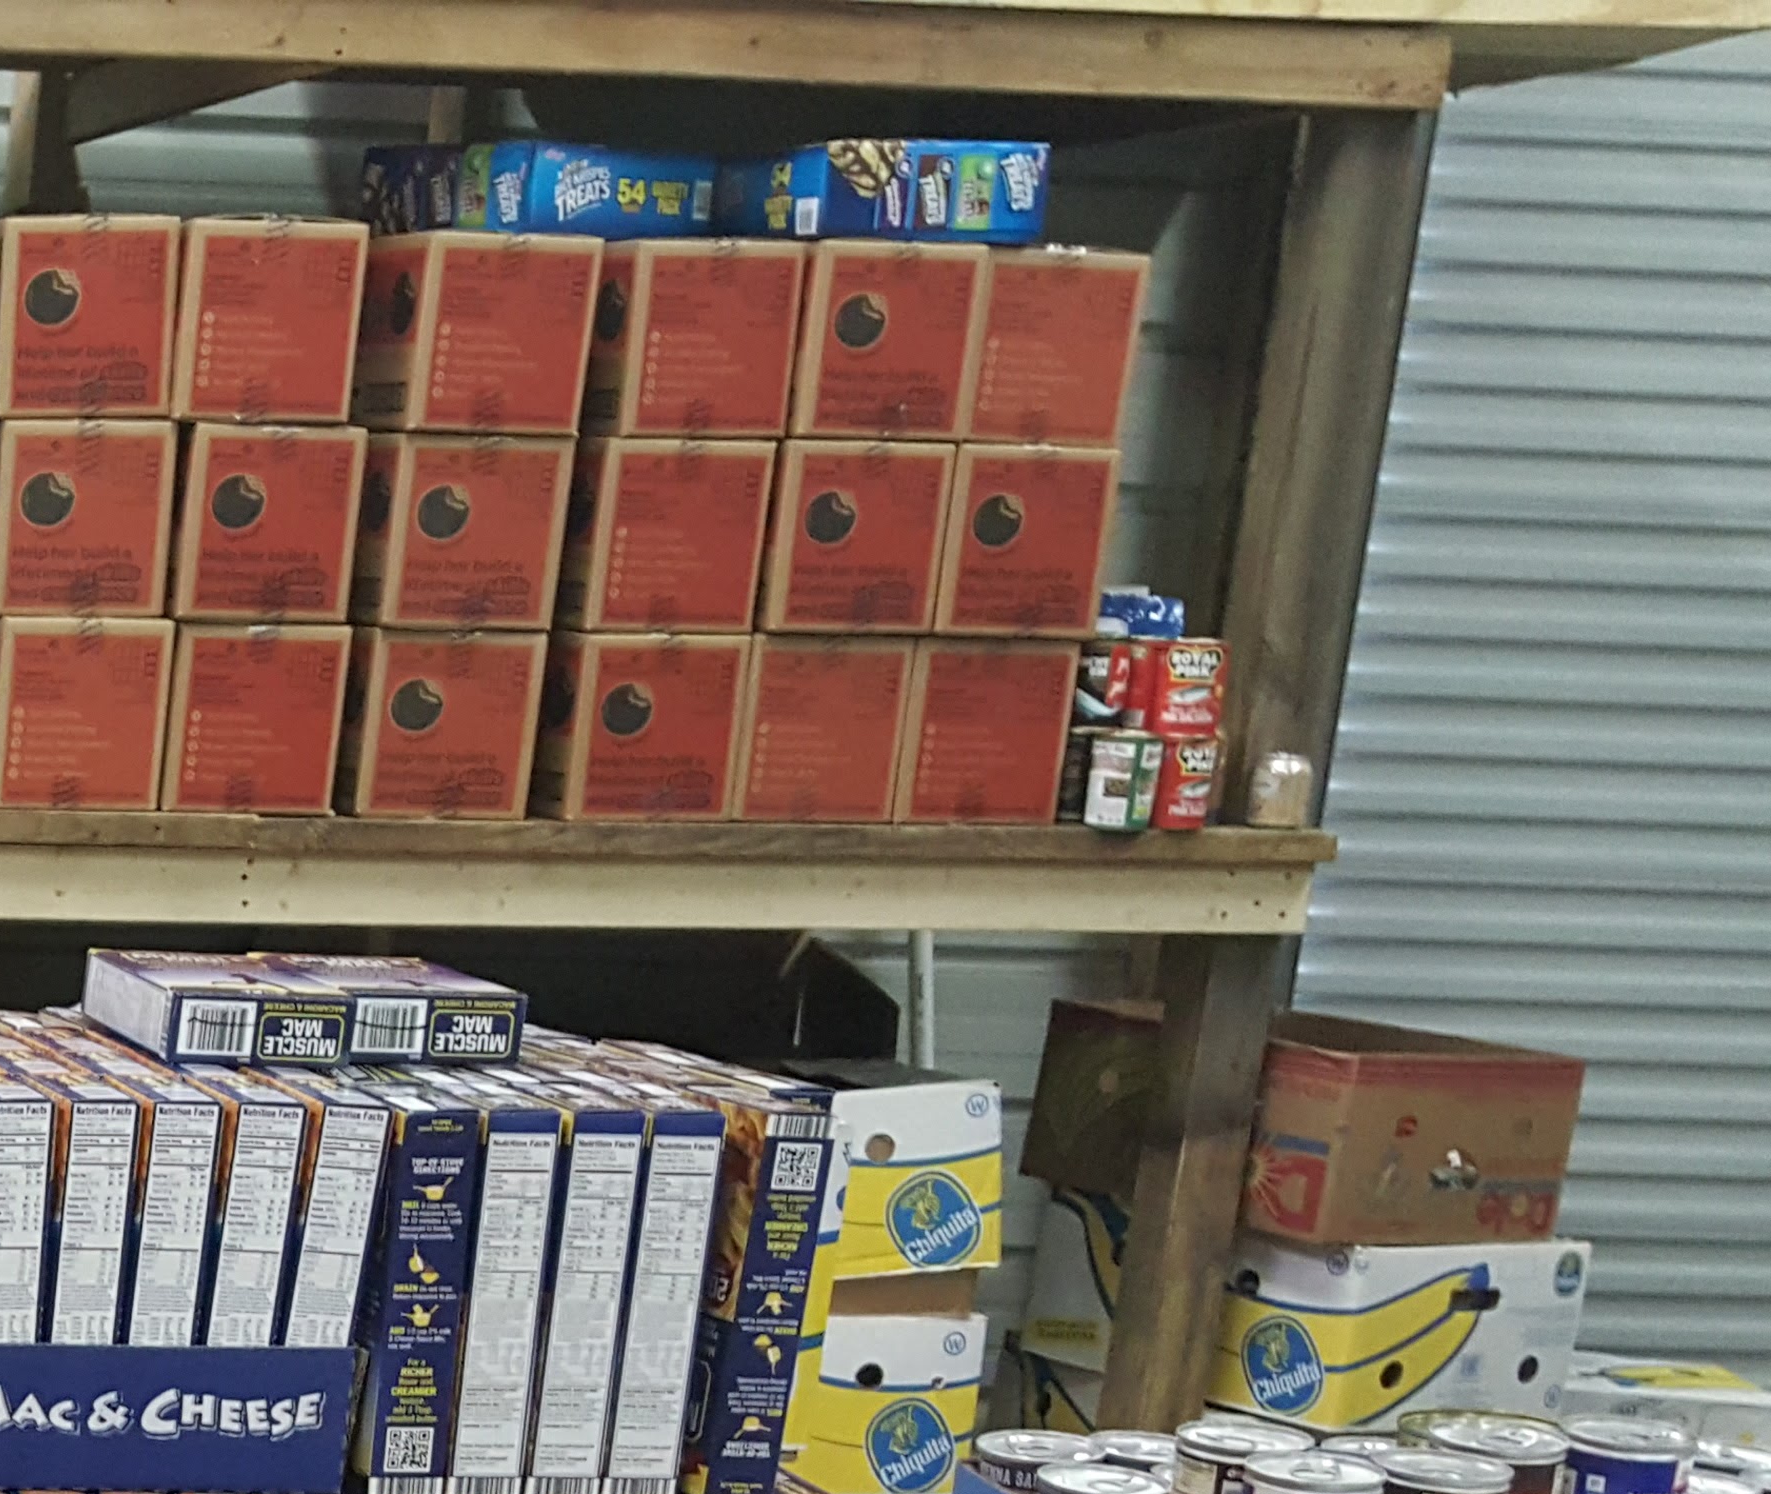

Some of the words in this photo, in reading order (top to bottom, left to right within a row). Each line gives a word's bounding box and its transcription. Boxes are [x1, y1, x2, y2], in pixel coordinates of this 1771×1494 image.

[617, 177, 647, 205] 54
[264, 1035, 335, 1056] MUSCLE
[283, 1019, 322, 1035] MAC
[904, 1205, 979, 1268] Chiquita
[1251, 1362, 1325, 1402] Chiquita
[88, 1391, 133, 1431] &
[140, 1388, 325, 1439] CHEESE
[879, 1432, 952, 1489] Chiquita
